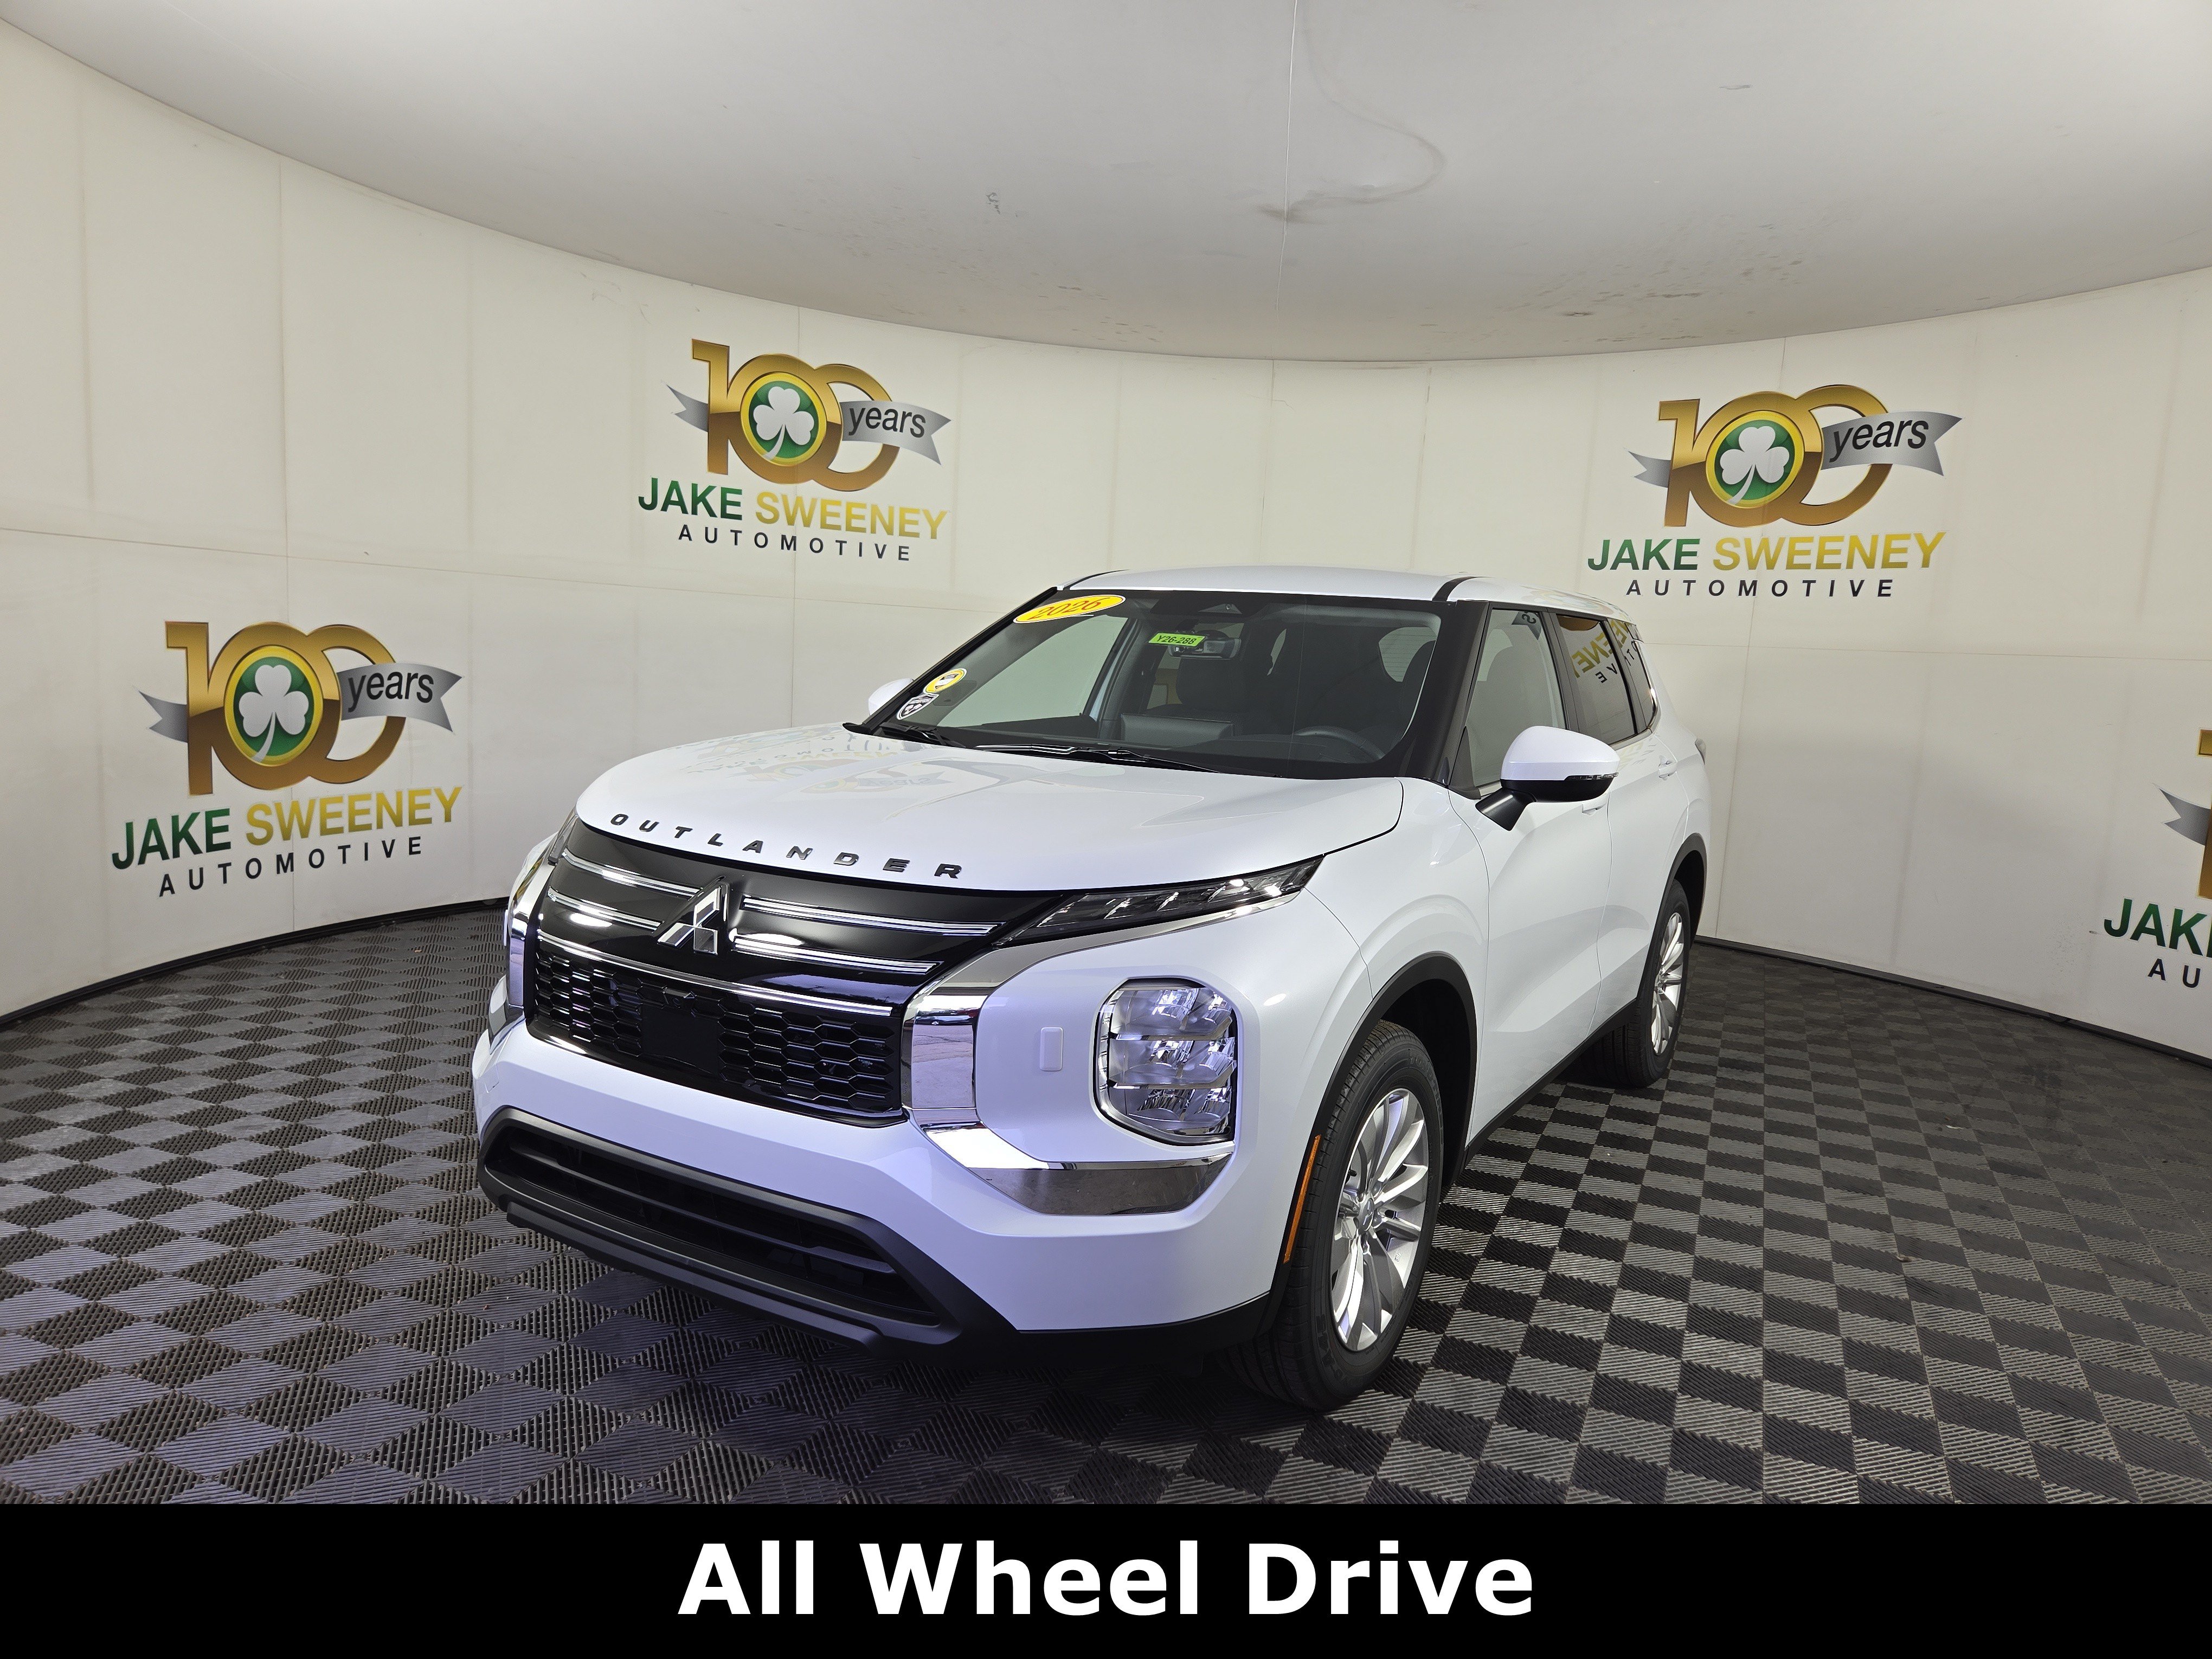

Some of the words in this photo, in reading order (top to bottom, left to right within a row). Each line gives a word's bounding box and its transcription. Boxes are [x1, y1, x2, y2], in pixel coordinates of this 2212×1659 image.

[848, 404, 925, 438] years
[1829, 417, 1929, 464] years
[638, 477, 743, 520] JAKE
[755, 492, 948, 539] SWEENEY
[678, 524, 909, 561] AUTOMOTIVE
[1587, 538, 1700, 571] JAKE
[1713, 532, 1946, 571] SWEENEY
[1027, 597, 1110, 620] 2026
[1626, 579, 1893, 597] AUTOMOTIVE
[1156, 635, 1197, 645] Y26-288
[348, 671, 434, 712] years
[112, 808, 231, 869] JAKE
[246, 786, 462, 846] SWEENEY
[610, 813, 962, 879] OUTLANDER
[159, 837, 421, 897] AUTOMOTIVE
[2104, 898, 2212, 959] JAK
